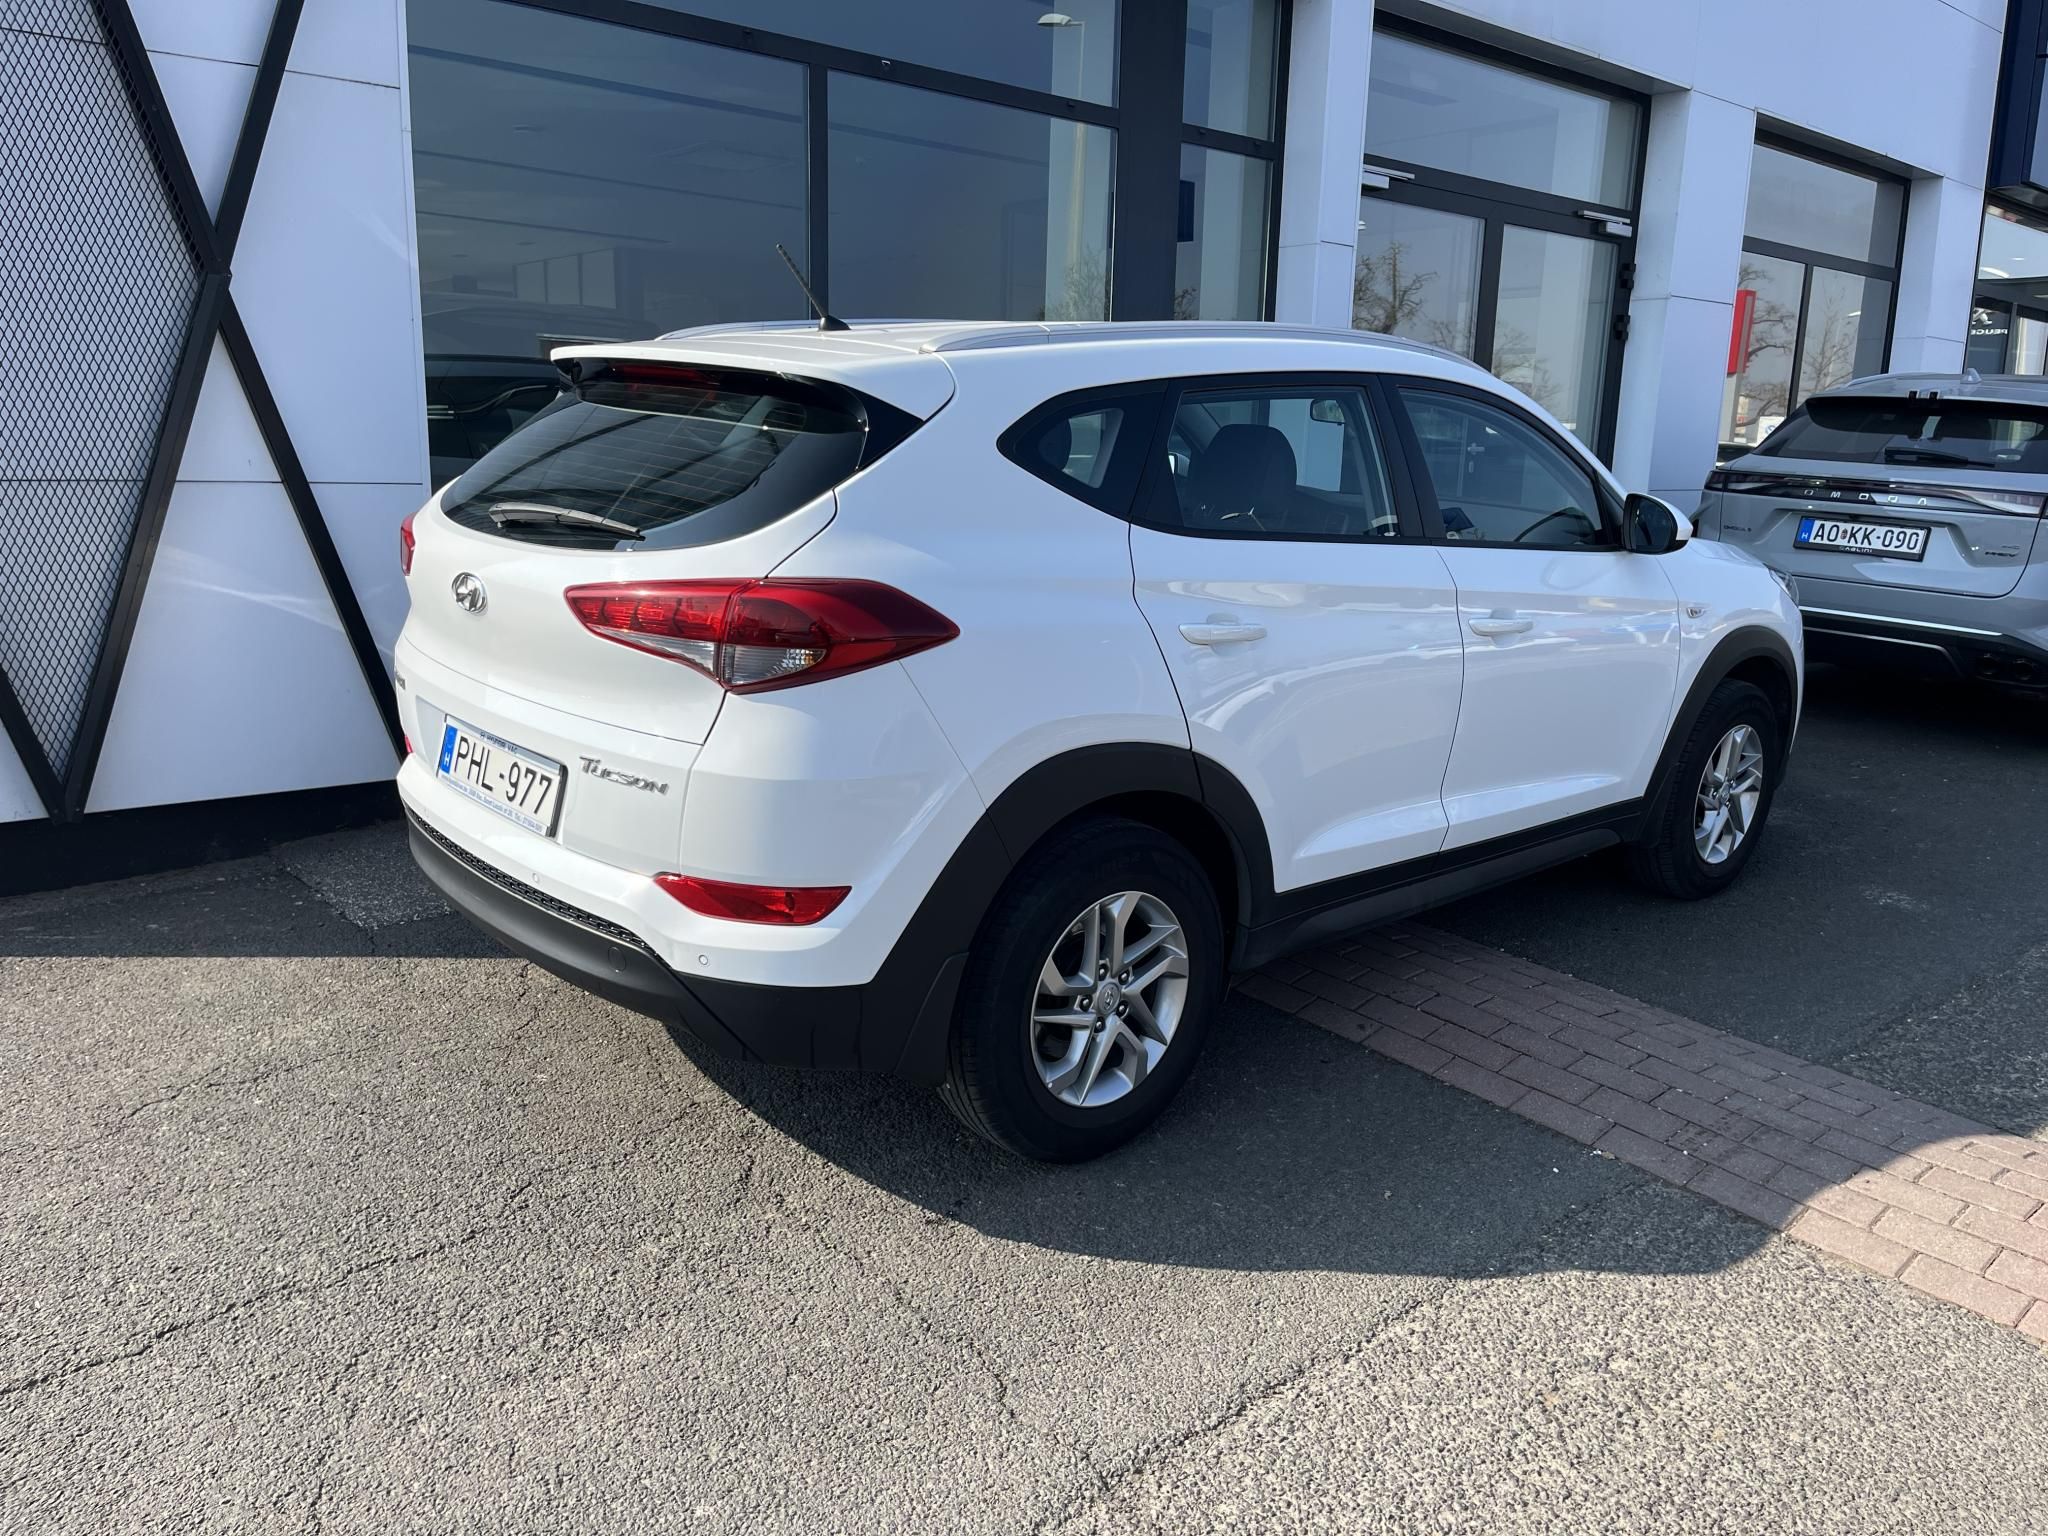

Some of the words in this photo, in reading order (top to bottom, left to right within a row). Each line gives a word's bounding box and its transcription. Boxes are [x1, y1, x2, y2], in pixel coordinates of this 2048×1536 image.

[1804, 489, 1927, 505] OMODA
[1801, 532, 1809, 540] H
[444, 753, 450, 767] H
[454, 735, 553, 815] PHL-977
